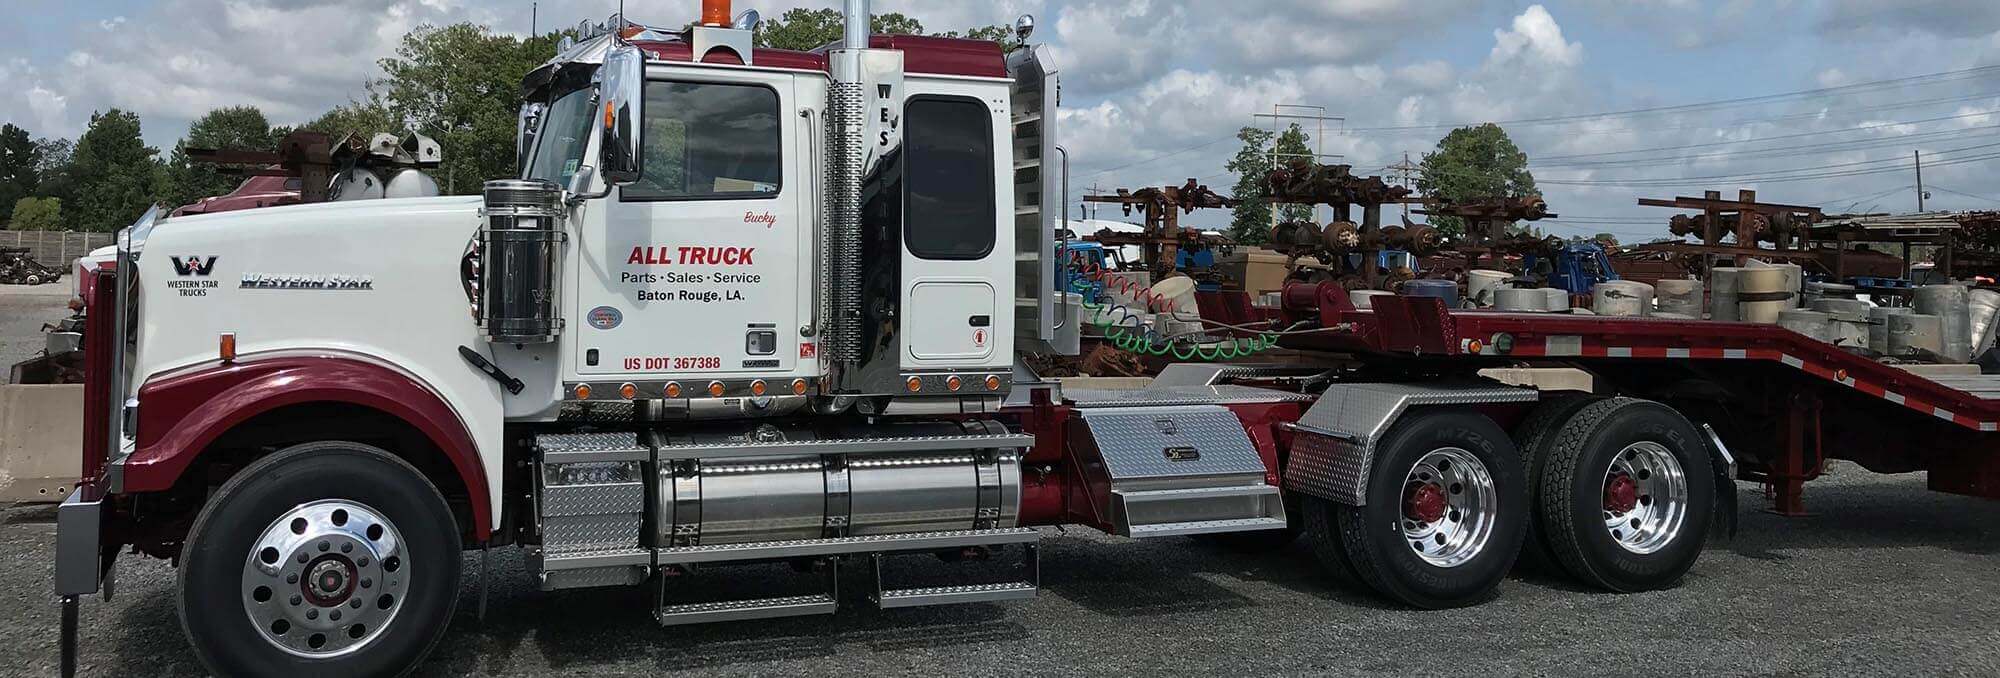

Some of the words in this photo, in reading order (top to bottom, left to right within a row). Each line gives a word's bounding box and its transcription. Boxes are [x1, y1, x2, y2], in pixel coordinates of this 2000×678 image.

[743, 211, 777, 228] Bucky
[627, 246, 671, 265] ALL
[678, 247, 755, 264] TRUCK
[238, 273, 326, 290] WESTERN
[327, 274, 375, 290] STAR
[621, 271, 657, 283] Parts
[667, 271, 704, 283] Sales
[713, 271, 761, 283] Service
[167, 280, 200, 289] WESTERN
[201, 280, 219, 288] STAR
[179, 288, 207, 297] TRUCKS
[637, 290, 675, 301] Baton
[679, 290, 722, 303] Rouge,
[725, 290, 746, 301] LA.
[624, 357, 641, 370] US
[645, 357, 670, 370] DOT
[674, 356, 721, 369] 367388
